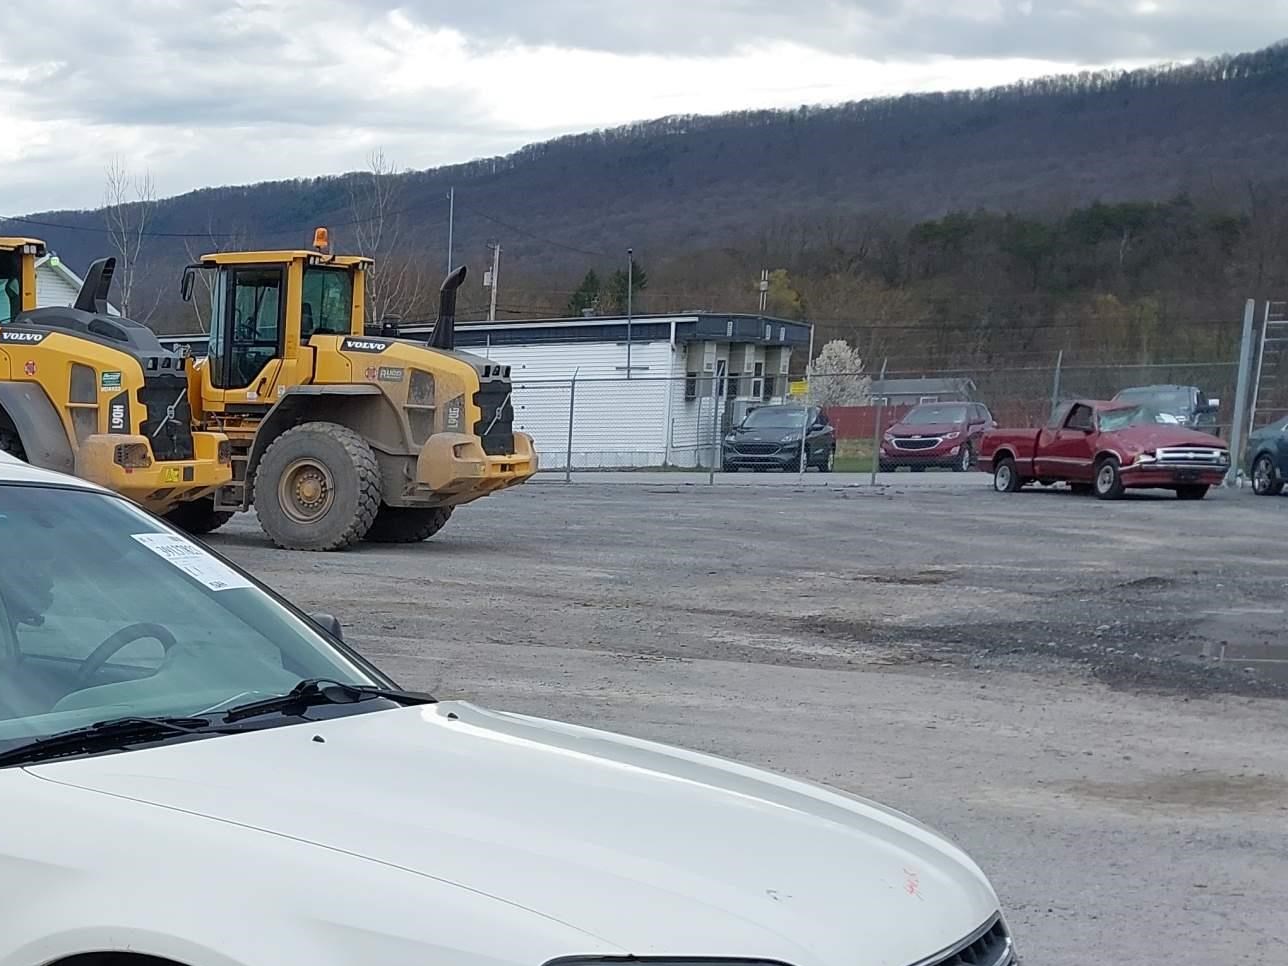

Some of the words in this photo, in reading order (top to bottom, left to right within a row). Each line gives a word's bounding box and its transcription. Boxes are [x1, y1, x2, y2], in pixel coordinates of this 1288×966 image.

[1, 332, 44, 341] VOLVO
[346, 340, 386, 350] VOLVO
[111, 404, 124, 429] L90H
